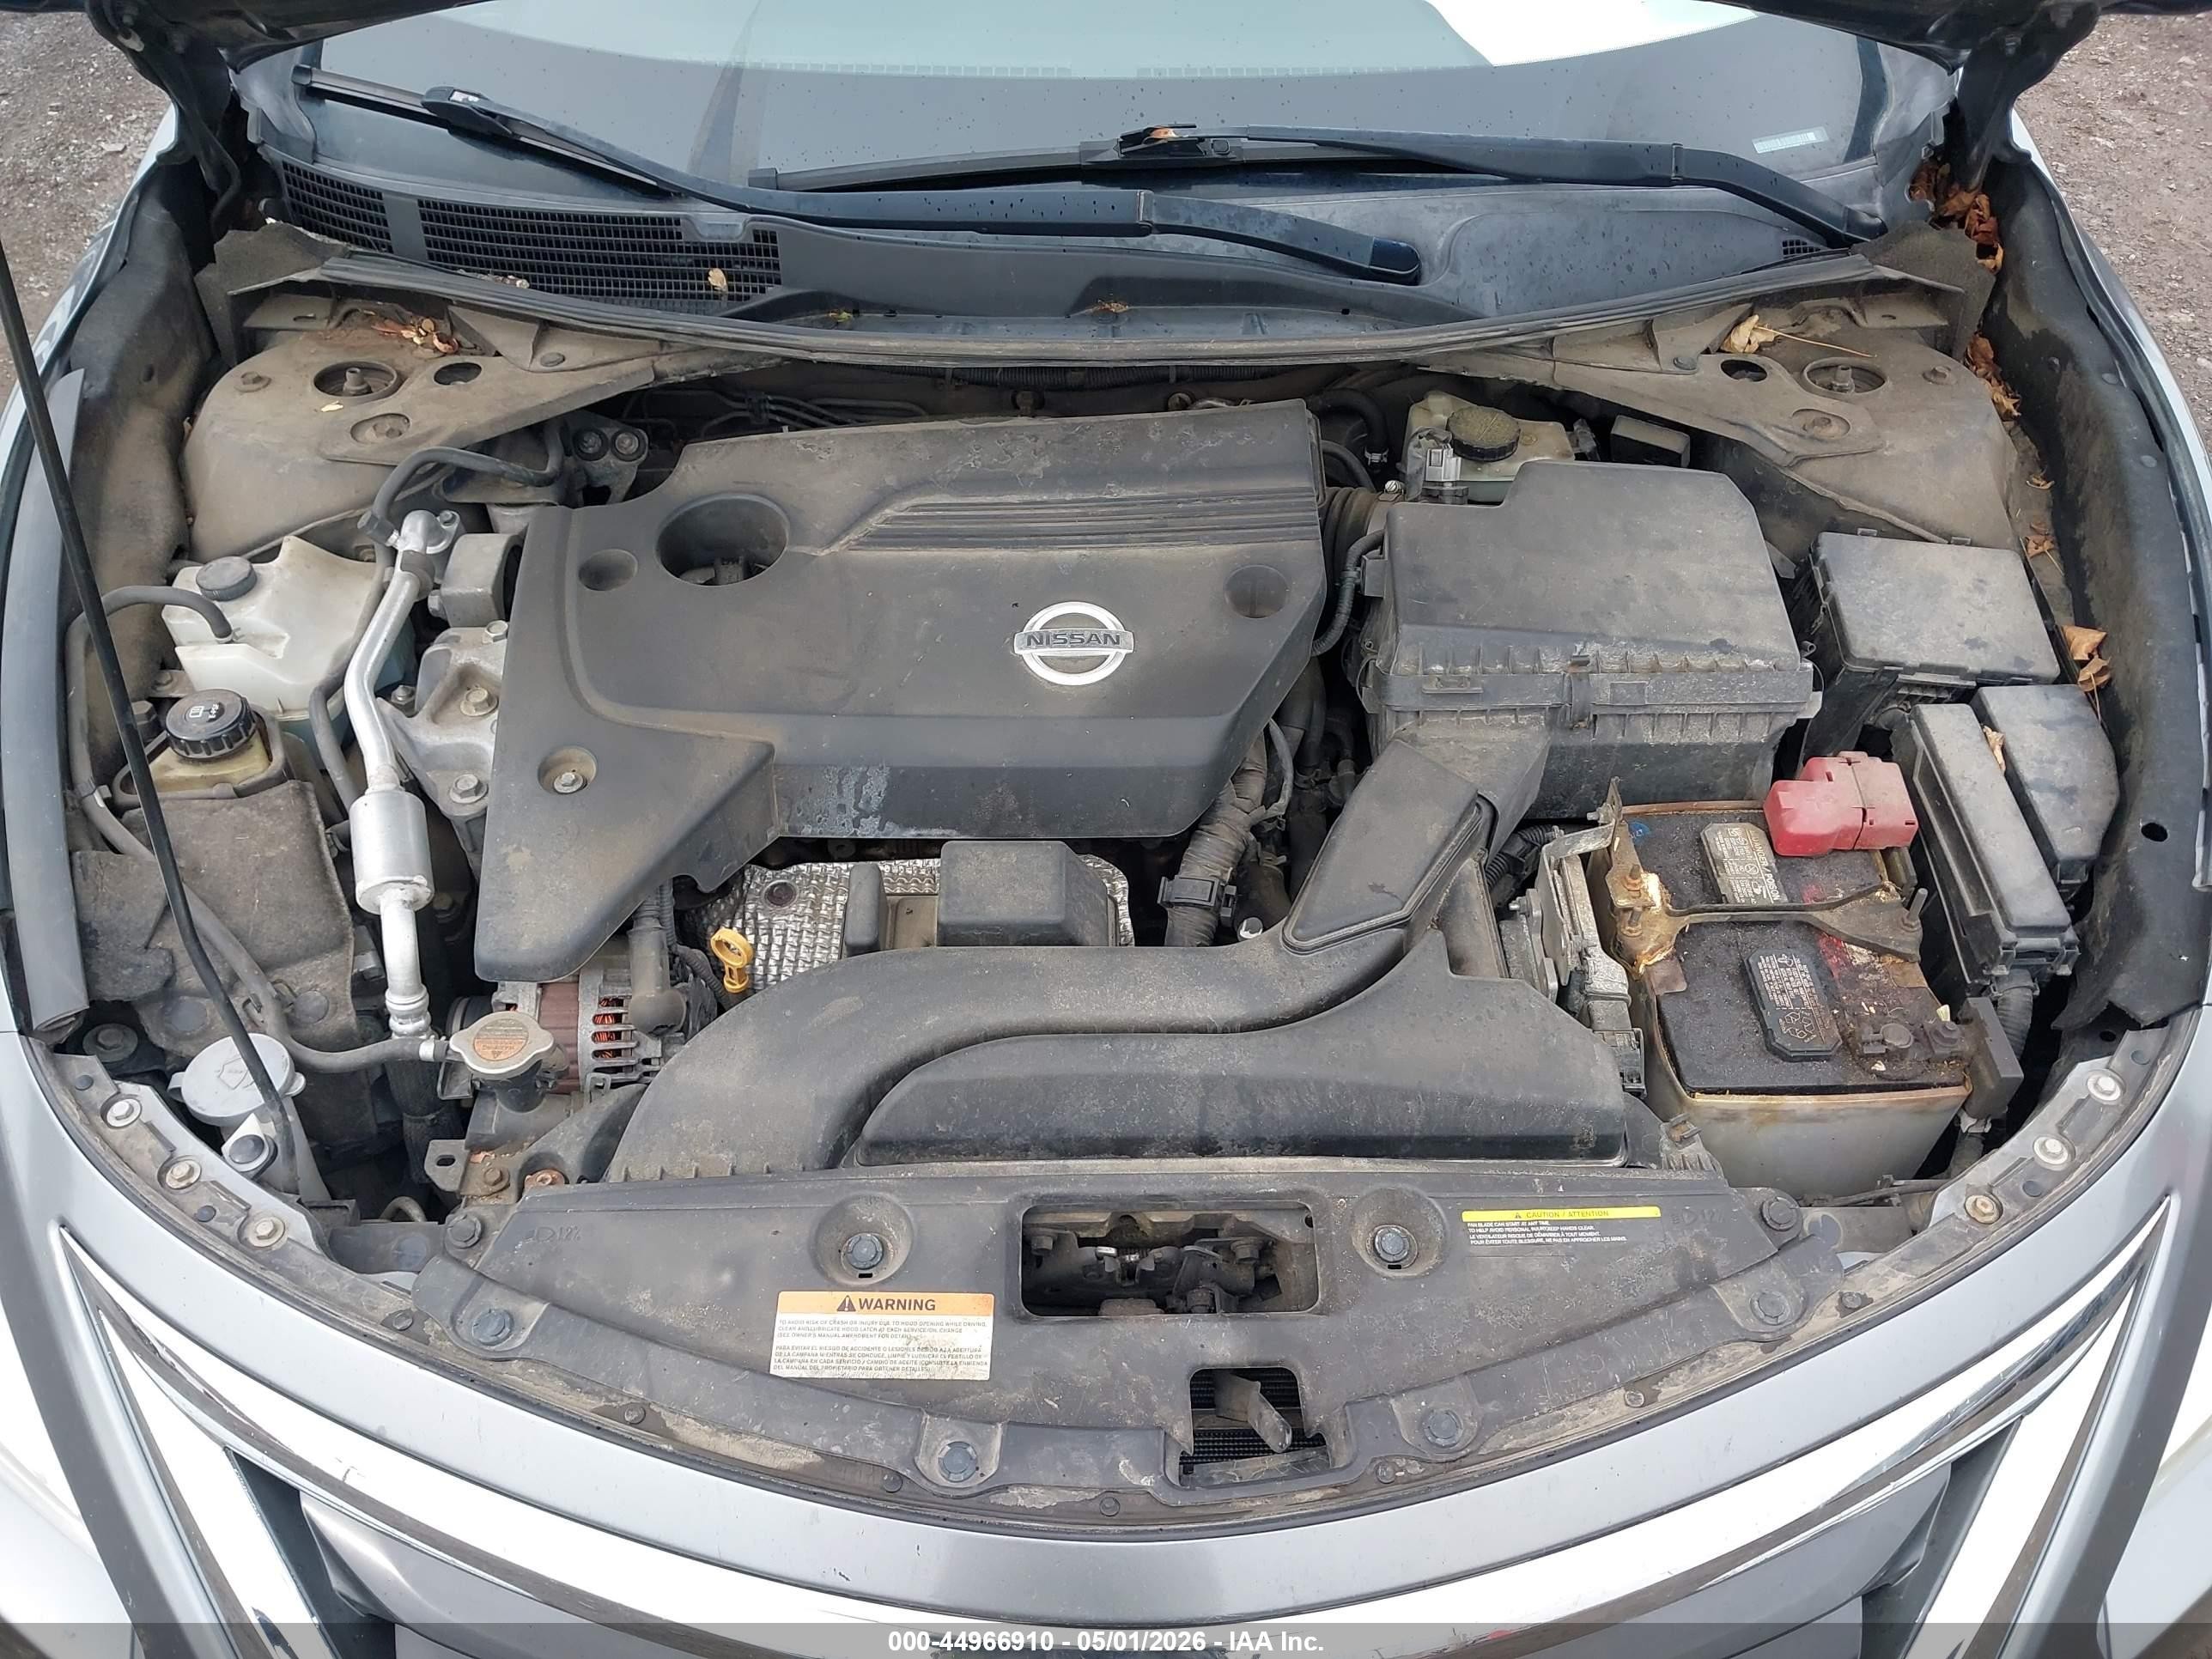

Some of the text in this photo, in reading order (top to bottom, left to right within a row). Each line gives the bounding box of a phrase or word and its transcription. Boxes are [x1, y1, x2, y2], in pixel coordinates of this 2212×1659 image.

[1026, 633, 1121, 647] NISSAN
[1751, 836, 1769, 866] DANGER
[1763, 873, 1781, 900] POISON
[859, 1297, 936, 1311] WARNING
